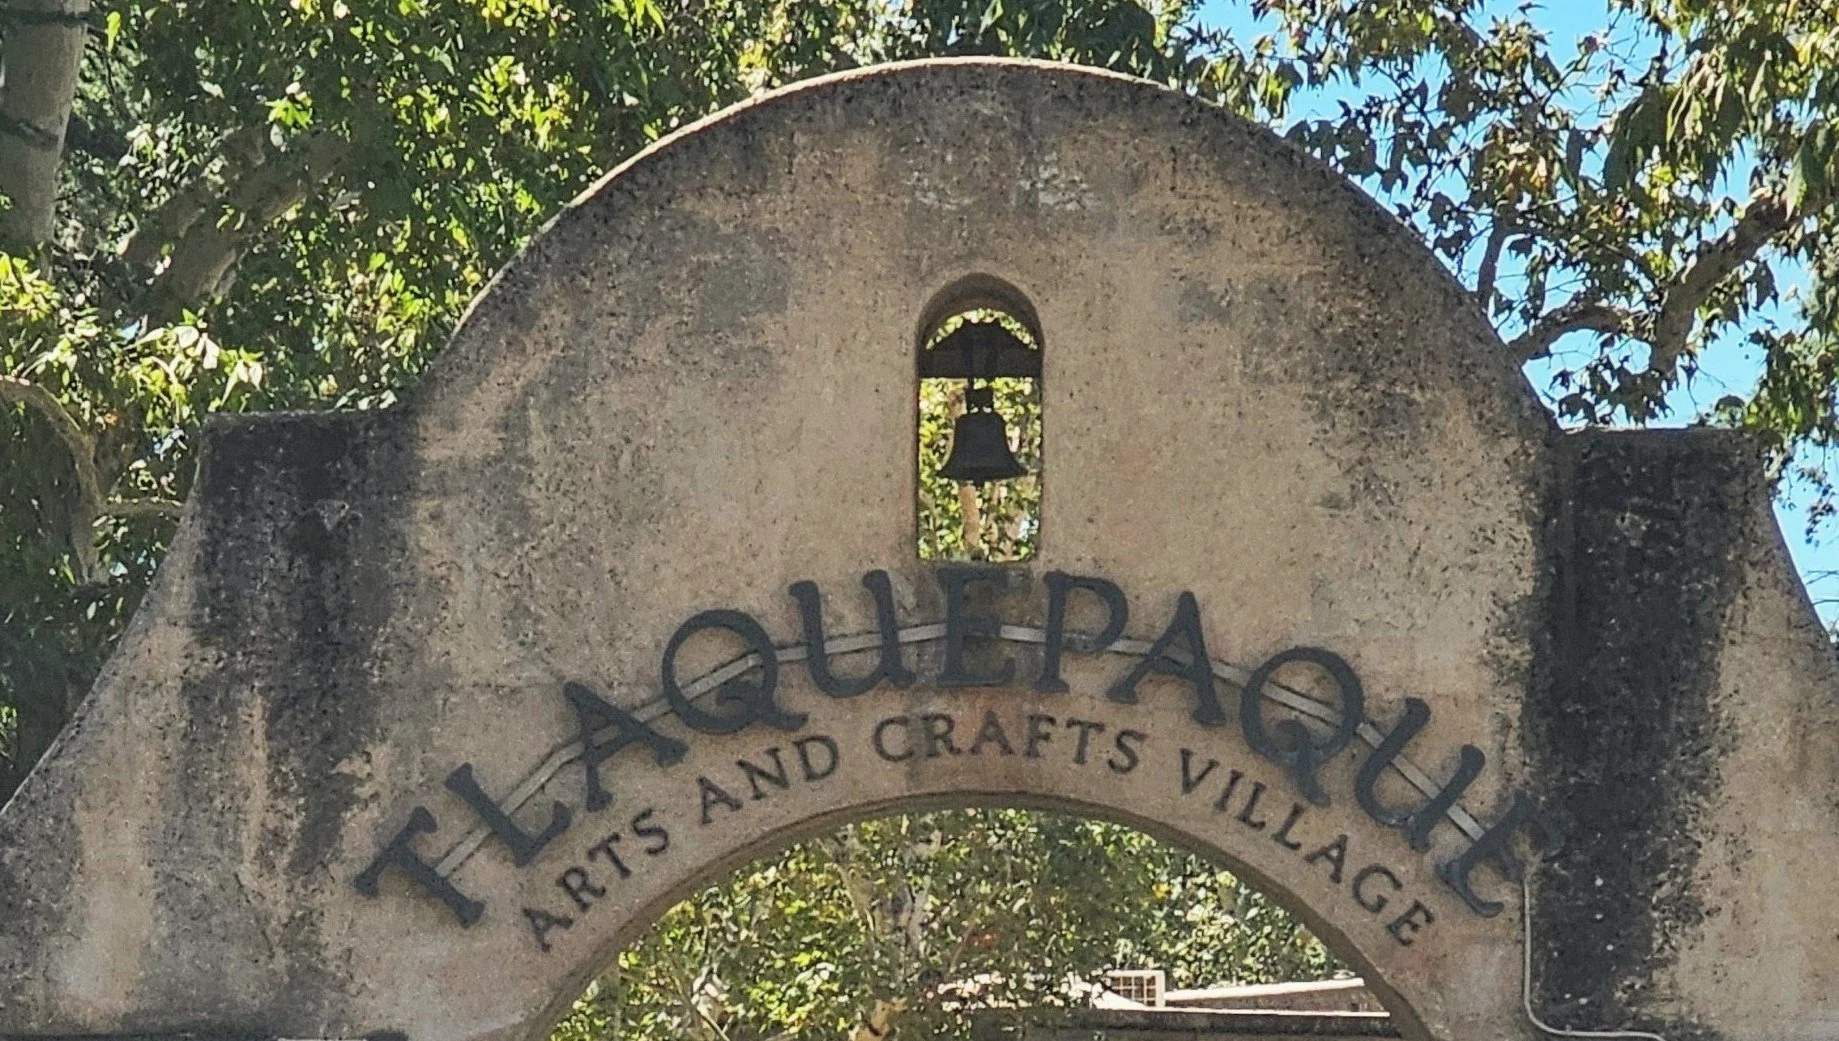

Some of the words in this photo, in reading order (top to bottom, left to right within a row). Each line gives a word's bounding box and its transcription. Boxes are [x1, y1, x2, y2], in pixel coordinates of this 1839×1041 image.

[353, 563, 1564, 928] TLAQUEPAQUE
[521, 809, 671, 953] ARTS
[697, 734, 840, 824] AND
[873, 713, 1149, 775] CRAFTS
[1178, 747, 1435, 947] VILLAGE
